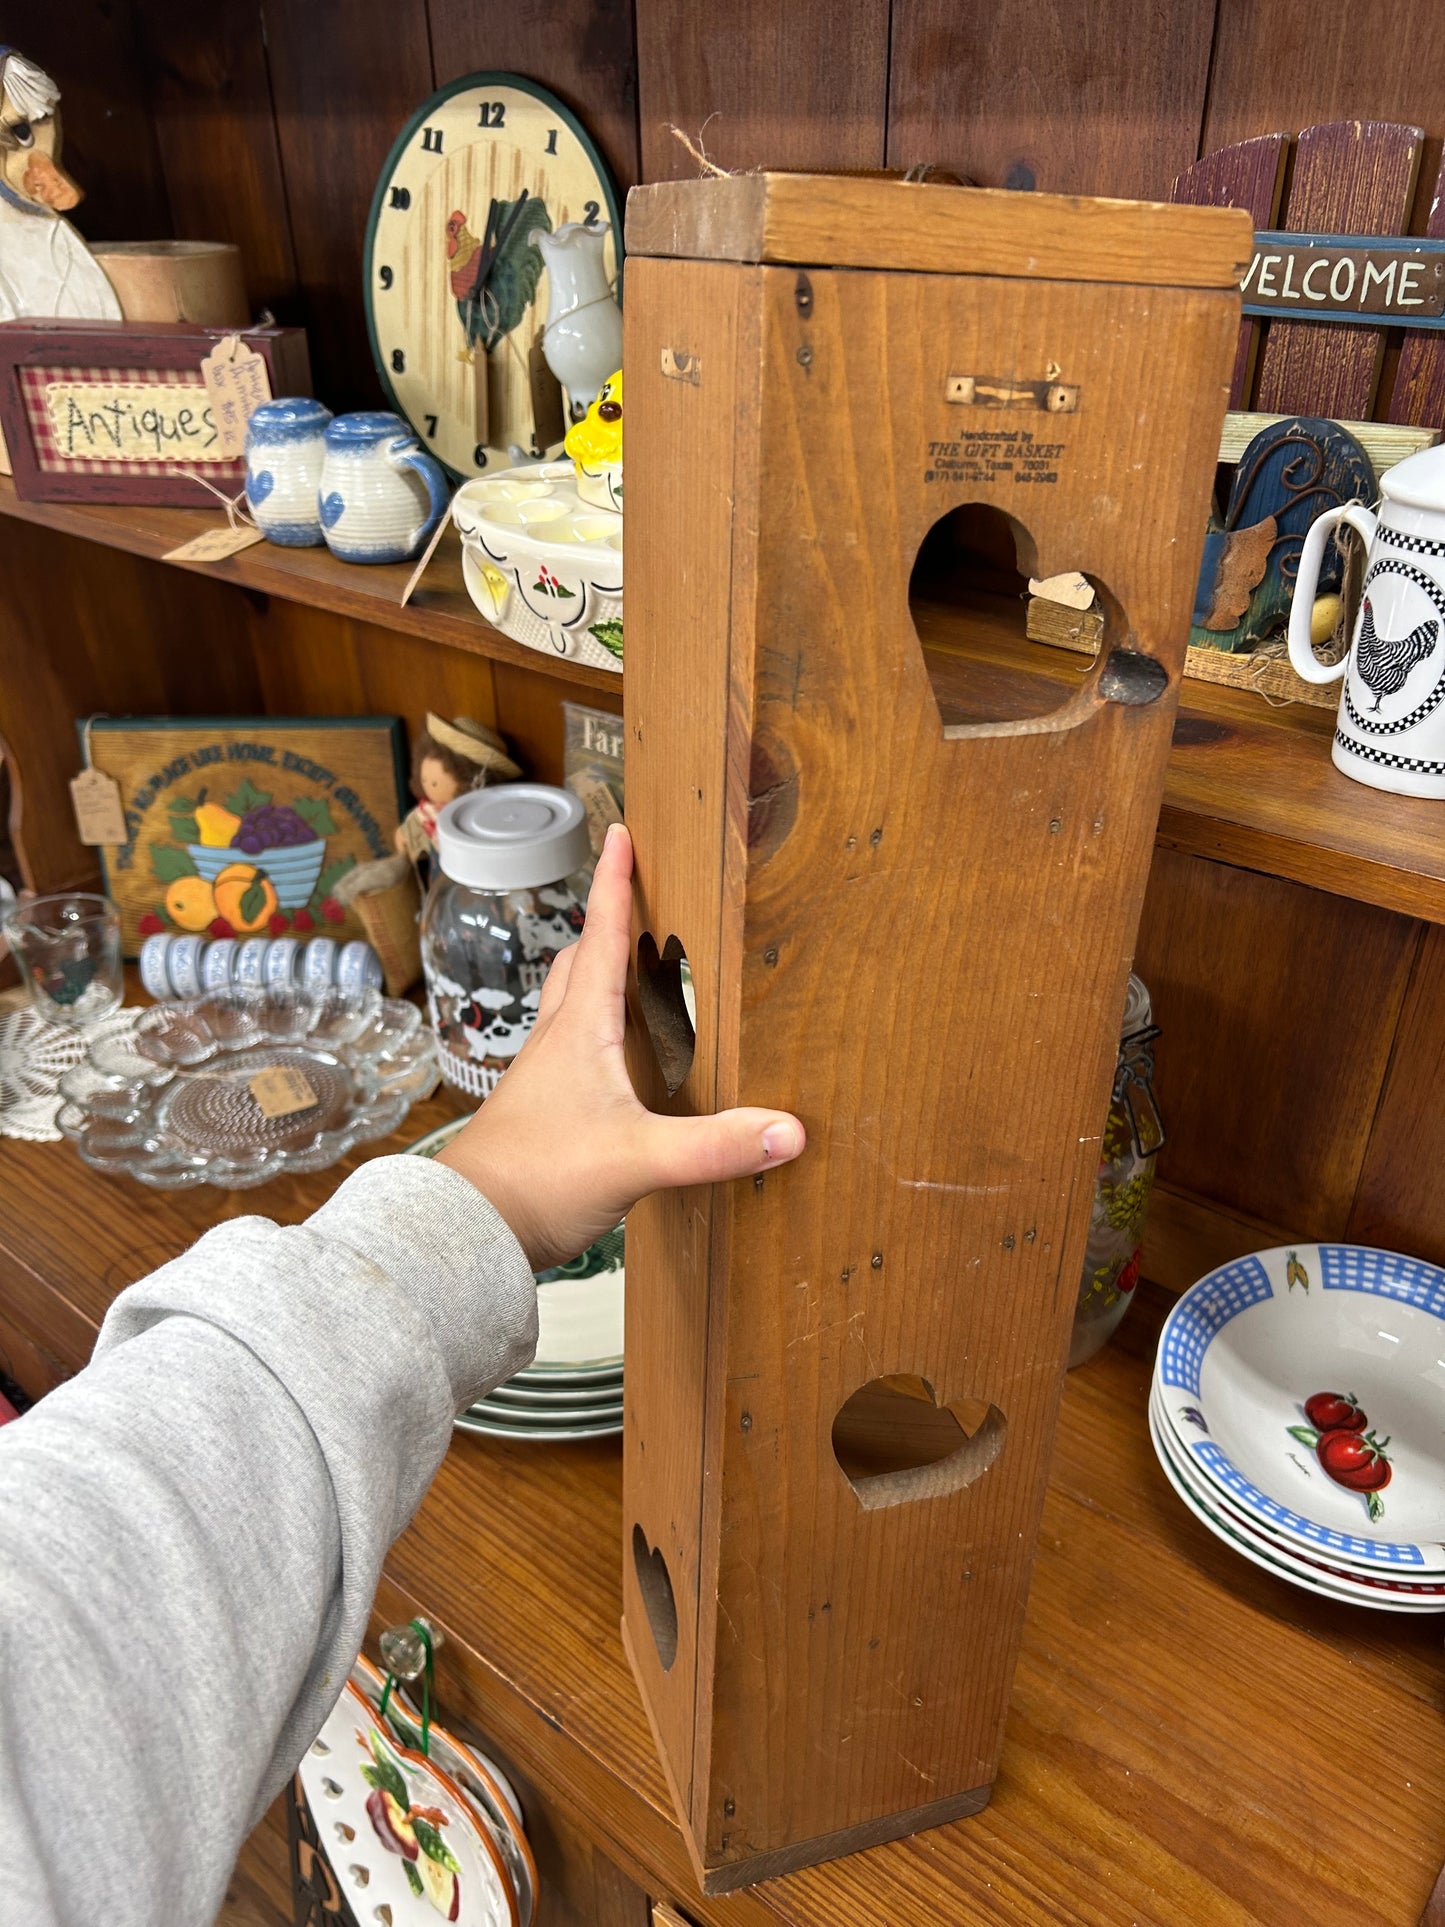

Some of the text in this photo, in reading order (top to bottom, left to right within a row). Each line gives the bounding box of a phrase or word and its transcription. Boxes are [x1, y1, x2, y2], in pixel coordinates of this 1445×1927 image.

[478, 102, 506, 128] 12
[421, 127, 444, 155] 11
[545, 129, 558, 155] 1
[584, 200, 601, 227] 2
[380, 265, 394, 290] 9
[391, 349, 405, 374] 8
[68, 397, 219, 452] Antiques
[424, 414, 438, 438] 7
[474, 444, 488, 468] 6
[928, 442, 1065, 458] THE GIFT BASKET
[582, 715, 624, 760] Far
